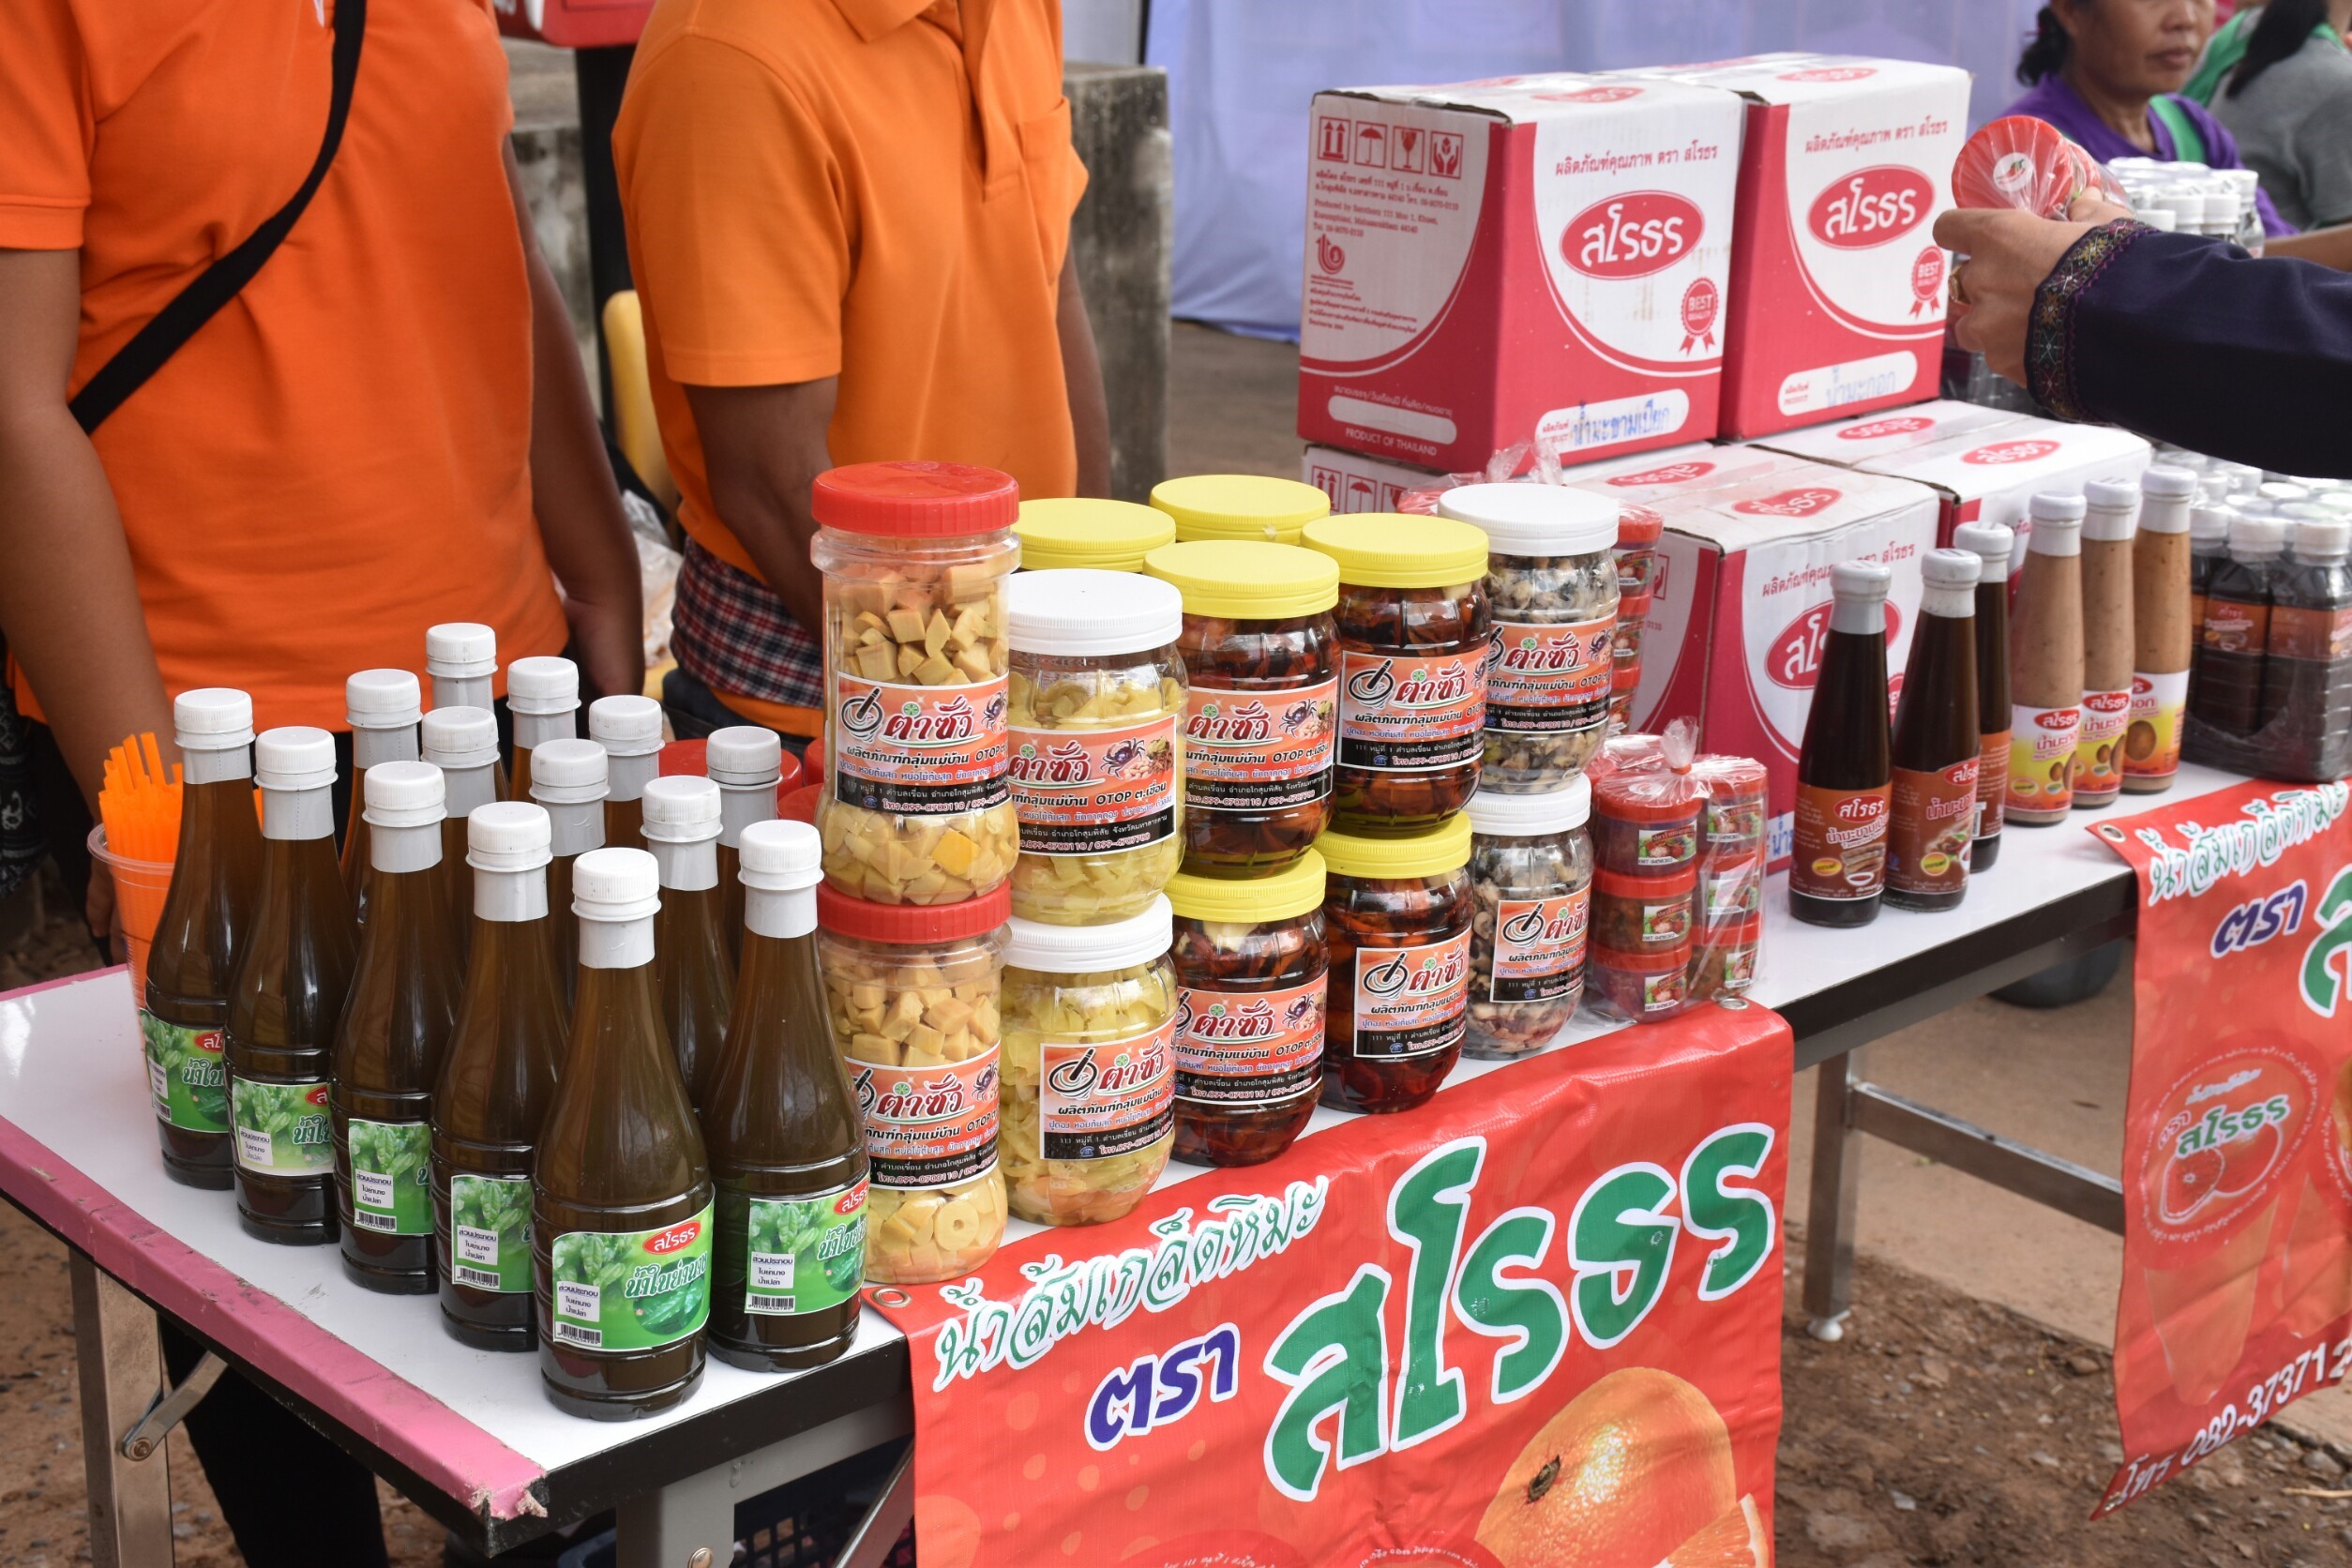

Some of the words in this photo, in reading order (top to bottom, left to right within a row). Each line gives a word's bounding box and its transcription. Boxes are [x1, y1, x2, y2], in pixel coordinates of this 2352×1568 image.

[1895, 127, 1914, 139] ตรา
[1556, 151, 1652, 176] ผลิตภัณฑ์คุณภาพ
[1658, 150, 1679, 164] ตรา
[1684, 140, 1718, 160] สโรธร
[1825, 177, 1917, 238] สโรธร
[1581, 203, 1683, 267] สโรธร
[1918, 261, 1940, 278] BEST
[1688, 294, 1712, 310] BEST
[1346, 428, 1380, 443] PRODUCT
[1383, 436, 1394, 445] OF
[1397, 439, 1437, 456] THAILAND
[1882, 540, 1915, 562] สโรธร
[1581, 675, 1601, 686] OTOP
[975, 747, 1000, 761] OTOP
[1273, 750, 1304, 761] OTOP
[1095, 791, 1132, 806] OTOP
[1839, 798, 1884, 818] สโรธร
[2210, 879, 2307, 958] ตรา
[1275, 1042, 1304, 1056] OTOP
[966, 1113, 992, 1132] OTOP
[2176, 1094, 2291, 1158] สโรธร
[654, 1227, 696, 1251] สโรธร
[1084, 1321, 1242, 1452] ตรา
[1262, 1122, 1778, 1501] สโรธร
